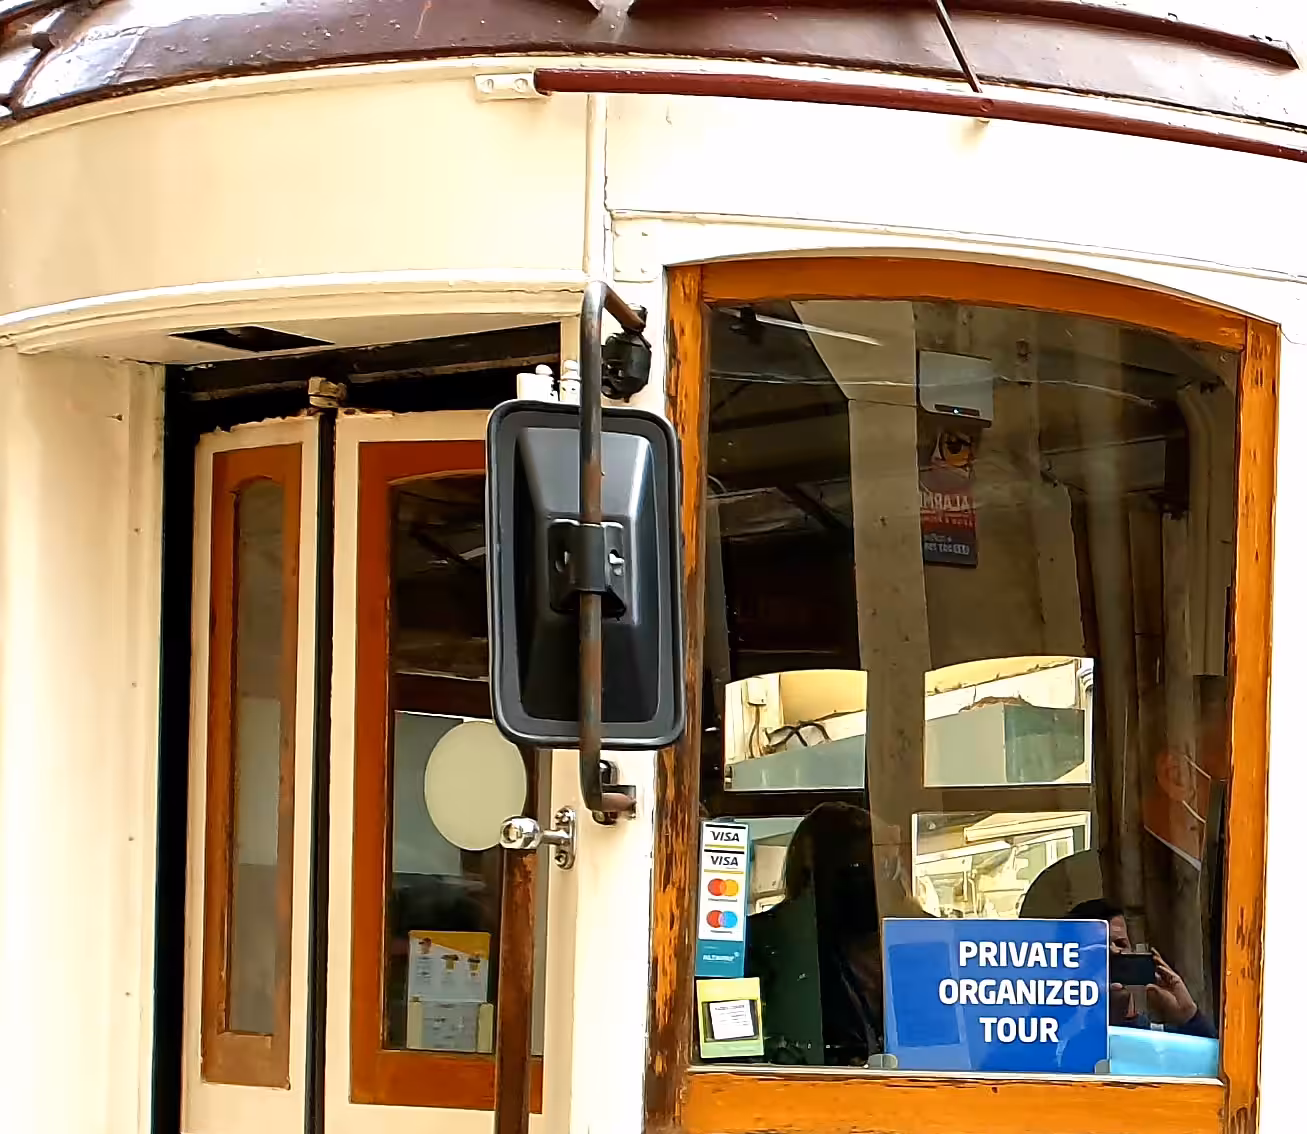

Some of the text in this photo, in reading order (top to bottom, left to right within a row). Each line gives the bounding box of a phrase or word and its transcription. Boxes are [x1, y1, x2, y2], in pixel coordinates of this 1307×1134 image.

[710, 830, 740, 842] VISA
[710, 855, 739, 867] VISA
[958, 940, 1080, 968] PRIVATE
[938, 977, 1100, 1007] ORGANIZED
[979, 1016, 1060, 1043] TOUR
